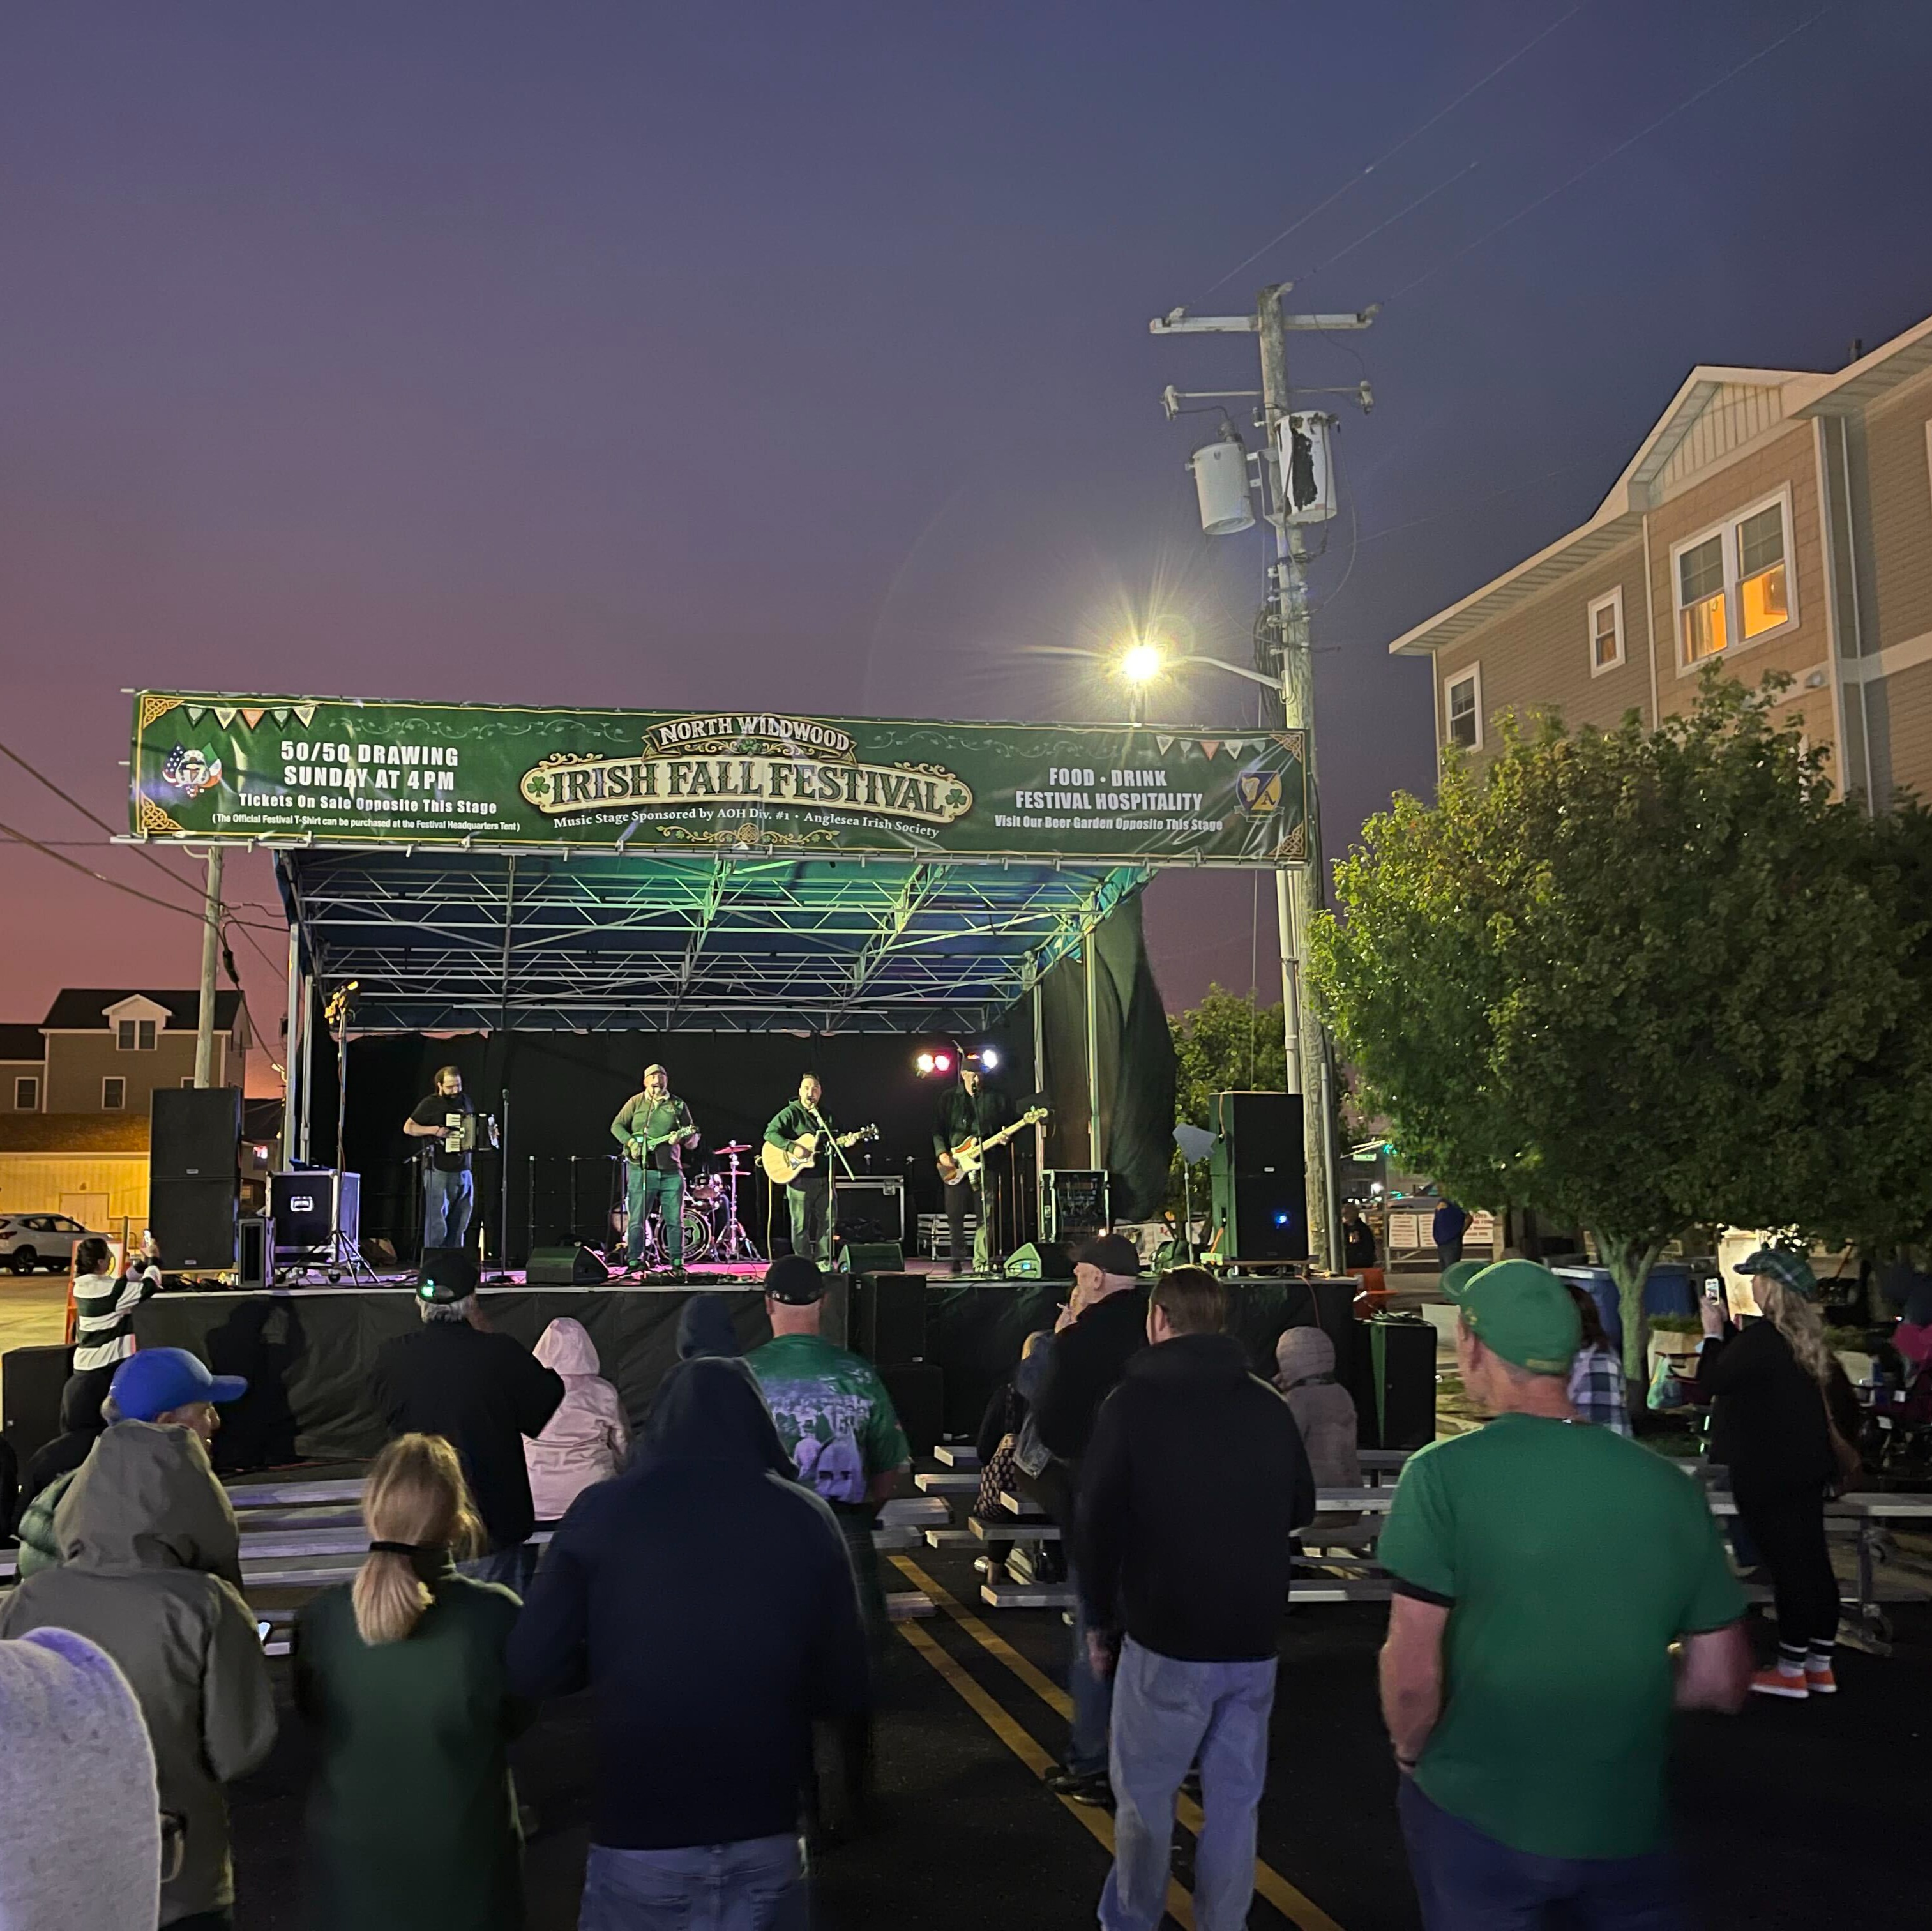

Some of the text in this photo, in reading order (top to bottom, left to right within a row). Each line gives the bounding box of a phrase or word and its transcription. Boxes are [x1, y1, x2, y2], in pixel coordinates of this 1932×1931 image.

[659, 716, 850, 752] NORTH WILDWOOD
[281, 741, 458, 766] 50/50 DRAWING
[284, 766, 368, 787] SUNDAY
[375, 769, 400, 789] AT
[1050, 768, 1168, 787] FOOD DRINK
[550, 761, 946, 817] IRISH FALL FESTIVAL
[239, 793, 497, 815] Tickets On Sale Opposite This Stage
[1016, 791, 1203, 811] FESTIVAL HOSPITALITY
[232, 814, 260, 824] Official
[262, 815, 293, 824] Festival
[294, 815, 321, 825] T-Shirt
[322, 817, 338, 826] can
[339, 817, 349, 826] be
[351, 818, 390, 828] purchased
[402, 820, 414, 828] the
[416, 820, 446, 829] Festival
[448, 821, 499, 830] Headquarters
[554, 808, 939, 838] Music Stage Sponsored by AOH Div. #1 Anglesea Irish Society
[995, 815, 1223, 832] Visit Our Beer Garden Opposite This Stage
